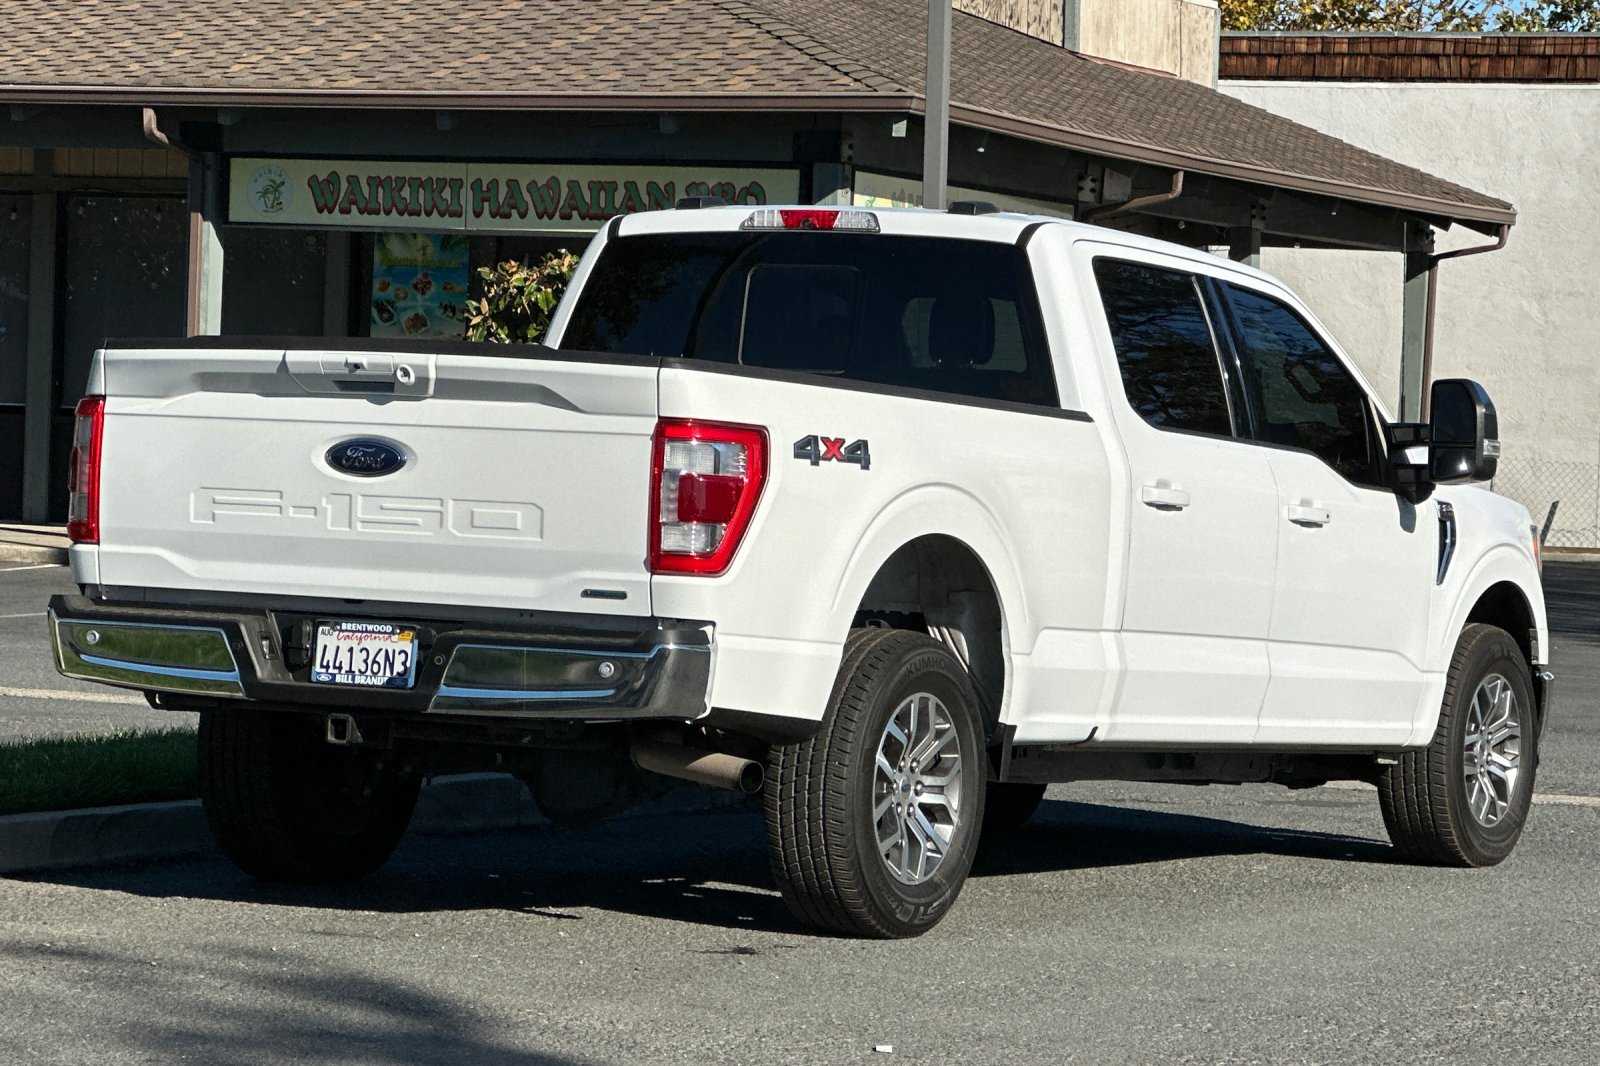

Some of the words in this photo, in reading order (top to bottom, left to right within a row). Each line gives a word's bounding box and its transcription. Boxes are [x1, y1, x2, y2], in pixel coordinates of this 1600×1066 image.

[307, 170, 464, 218] WAIKIKI
[470, 175, 676, 220] HAWAIIAN
[341, 447, 387, 468] Ford
[190, 486, 544, 541] F-150
[320, 626, 334, 636] AUG
[341, 622, 393, 633] BRENTWOOD
[336, 630, 394, 645] California
[320, 644, 409, 677] 44136N3
[335, 673, 353, 684] BILL
